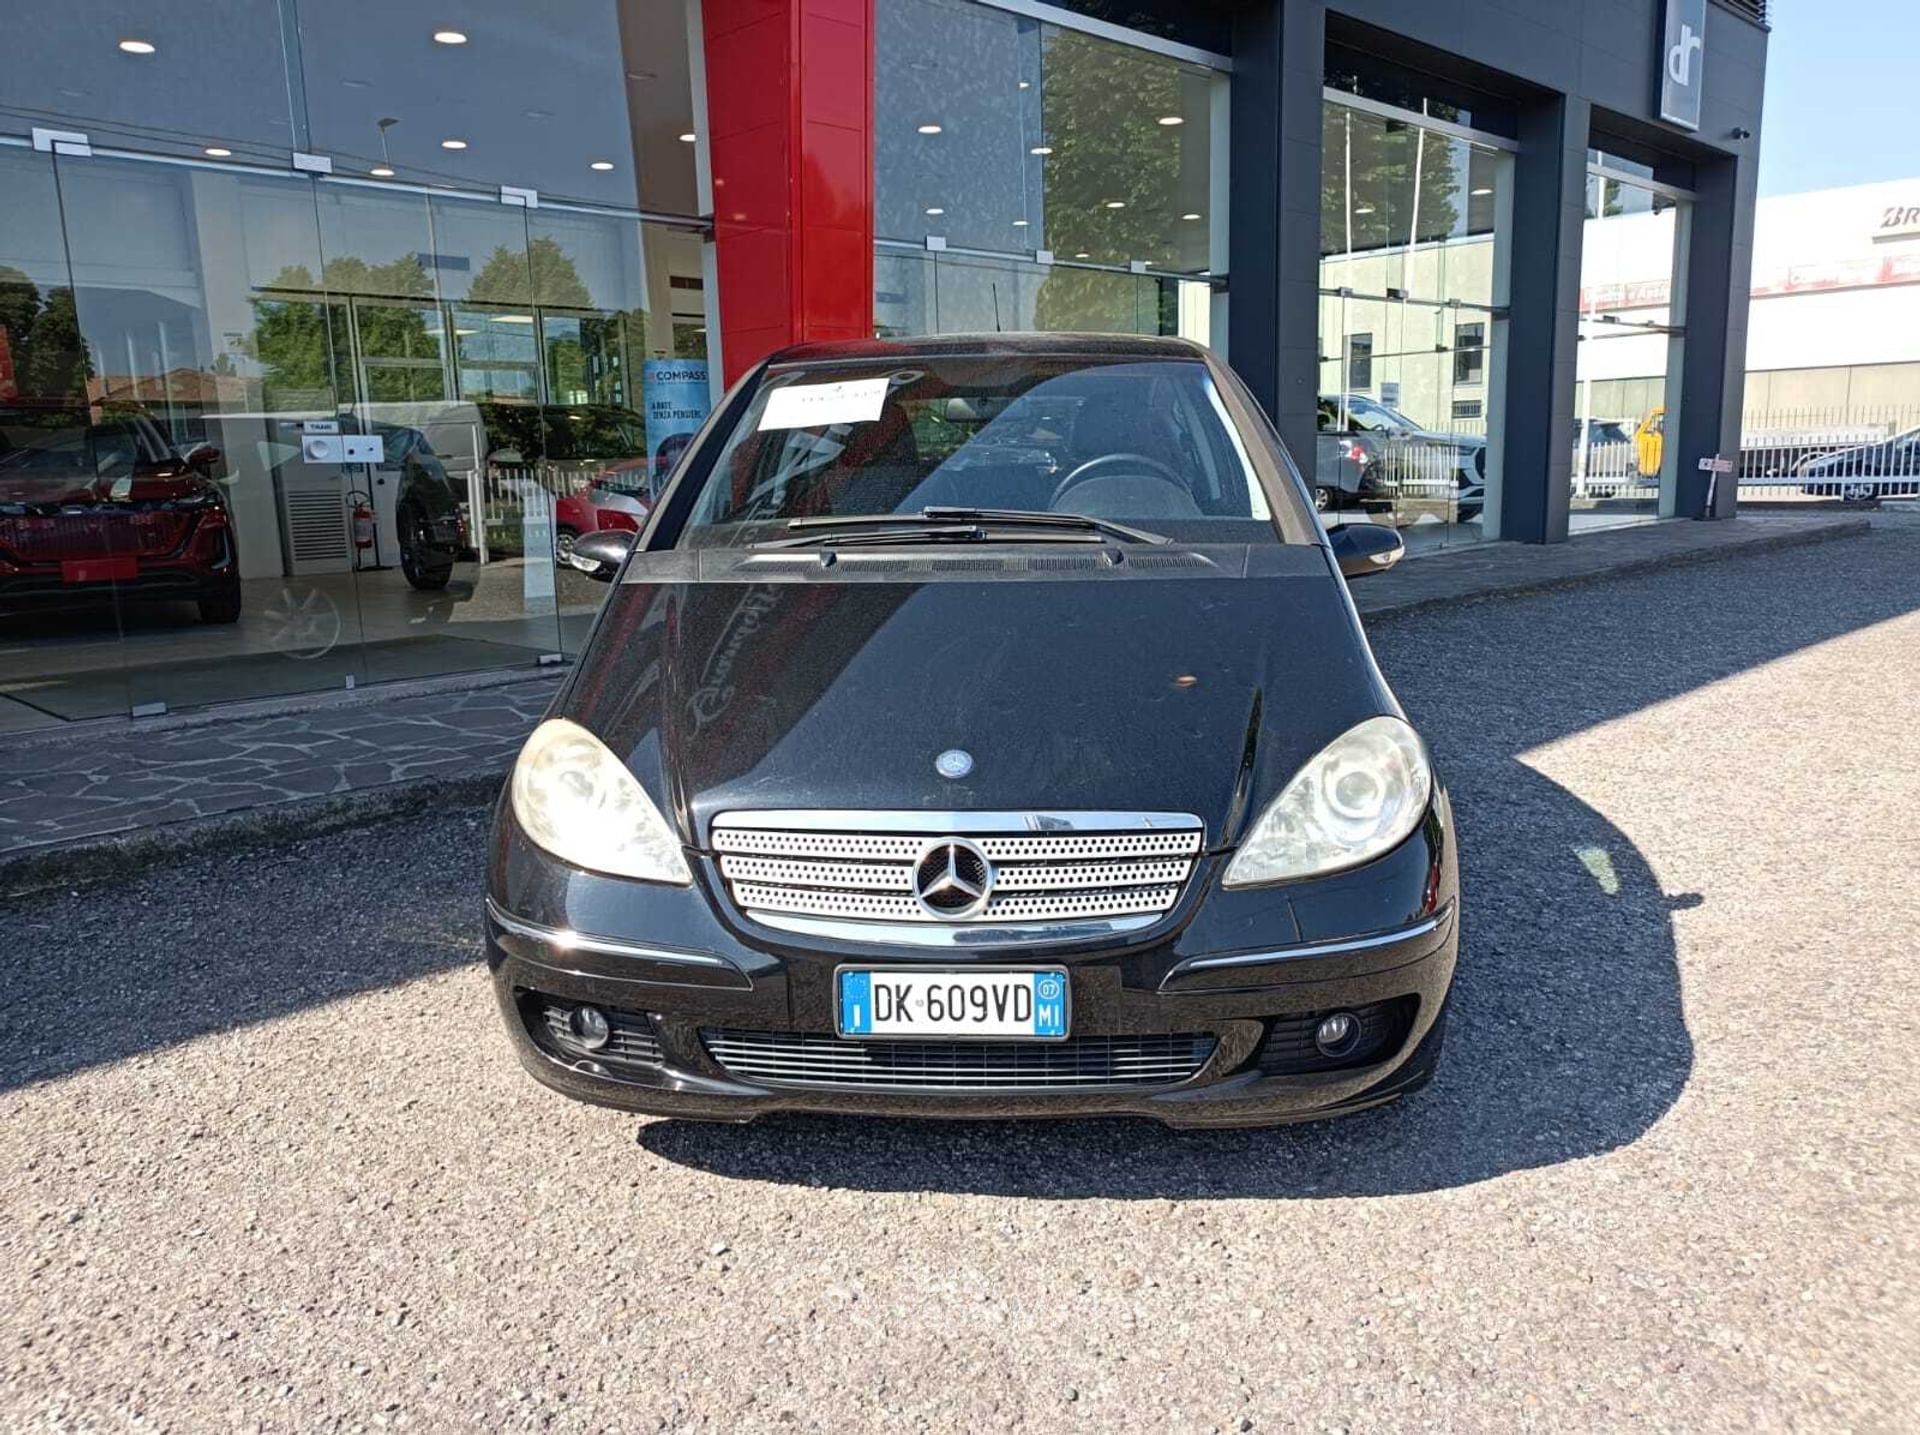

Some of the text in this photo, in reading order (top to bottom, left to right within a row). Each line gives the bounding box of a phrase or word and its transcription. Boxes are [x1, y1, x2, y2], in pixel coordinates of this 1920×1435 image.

[1668, 24, 1701, 87] dr
[656, 371, 707, 381] COMPASS
[874, 984, 1032, 1022] DK 609VD
[853, 1004, 861, 1027] I
[1038, 1004, 1060, 1027] MI
